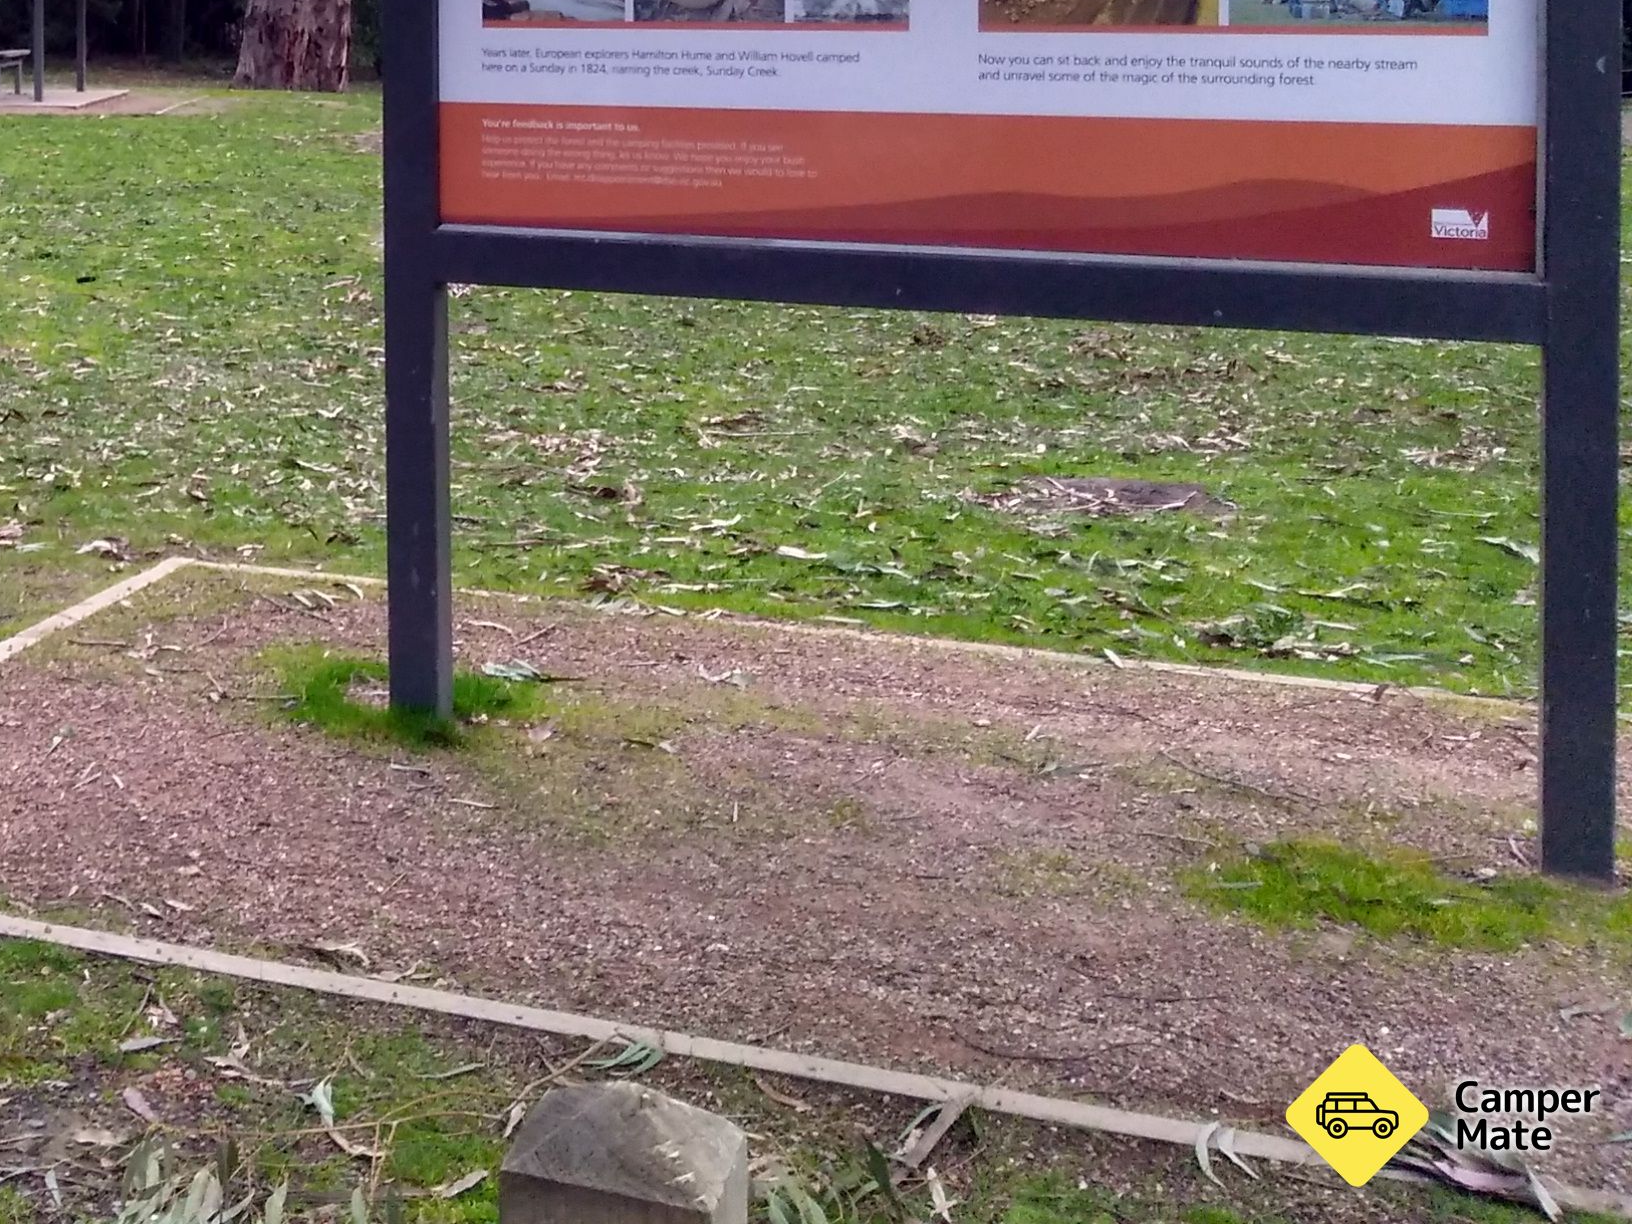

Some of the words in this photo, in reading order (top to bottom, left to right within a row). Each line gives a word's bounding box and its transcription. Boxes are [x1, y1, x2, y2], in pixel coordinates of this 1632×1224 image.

[978, 54, 1005, 64] Now
[1008, 57, 1029, 68] you
[1033, 57, 1053, 65] can
[1057, 54, 1069, 65] sit
[1073, 55, 1099, 65] back
[1105, 55, 1127, 66] and
[1131, 55, 1163, 70] enjoy
[1167, 56, 1185, 66] the
[1190, 56, 1235, 70] tranquil
[1239, 56, 1283, 67] sounds
[1304, 57, 1323, 68] the
[1328, 57, 1370, 72] nearby
[1375, 58, 1417, 69] stream
[978, 70, 1000, 81] and
[1003, 70, 1044, 81] unravel
[1048, 74, 1079, 82] some
[1099, 71, 1118, 82] the
[1122, 72, 1157, 86] magic
[1178, 72, 1197, 83] the
[1201, 73, 1275, 88] surrounding
[1434, 225, 1486, 238] Victoria
